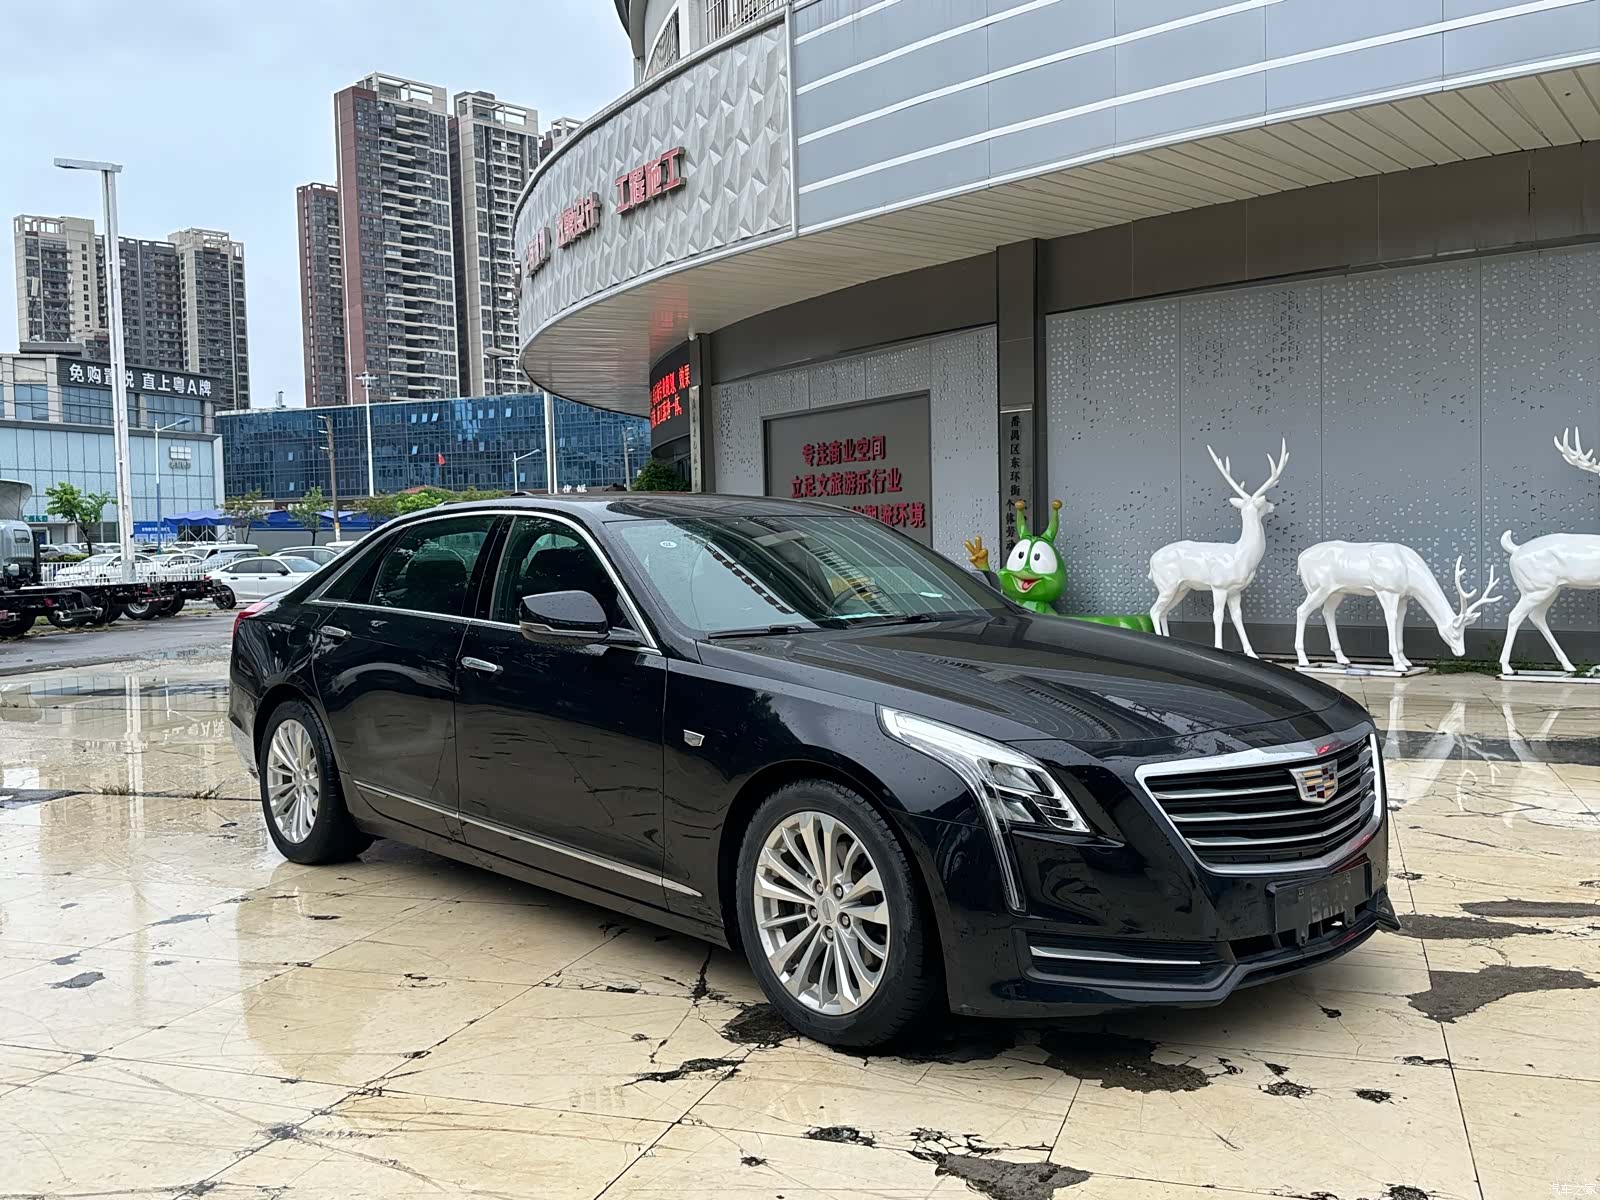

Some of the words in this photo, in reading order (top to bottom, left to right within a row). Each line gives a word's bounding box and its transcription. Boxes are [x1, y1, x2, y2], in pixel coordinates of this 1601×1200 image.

[614, 146, 687, 215] 工程施工
[141, 372, 211, 397] 直上粤A牌
[801, 435, 887, 467] 专注商业空间
[1010, 415, 1021, 497] 番禺区东环街
[790, 467, 902, 498] 立足文旅游乐行业
